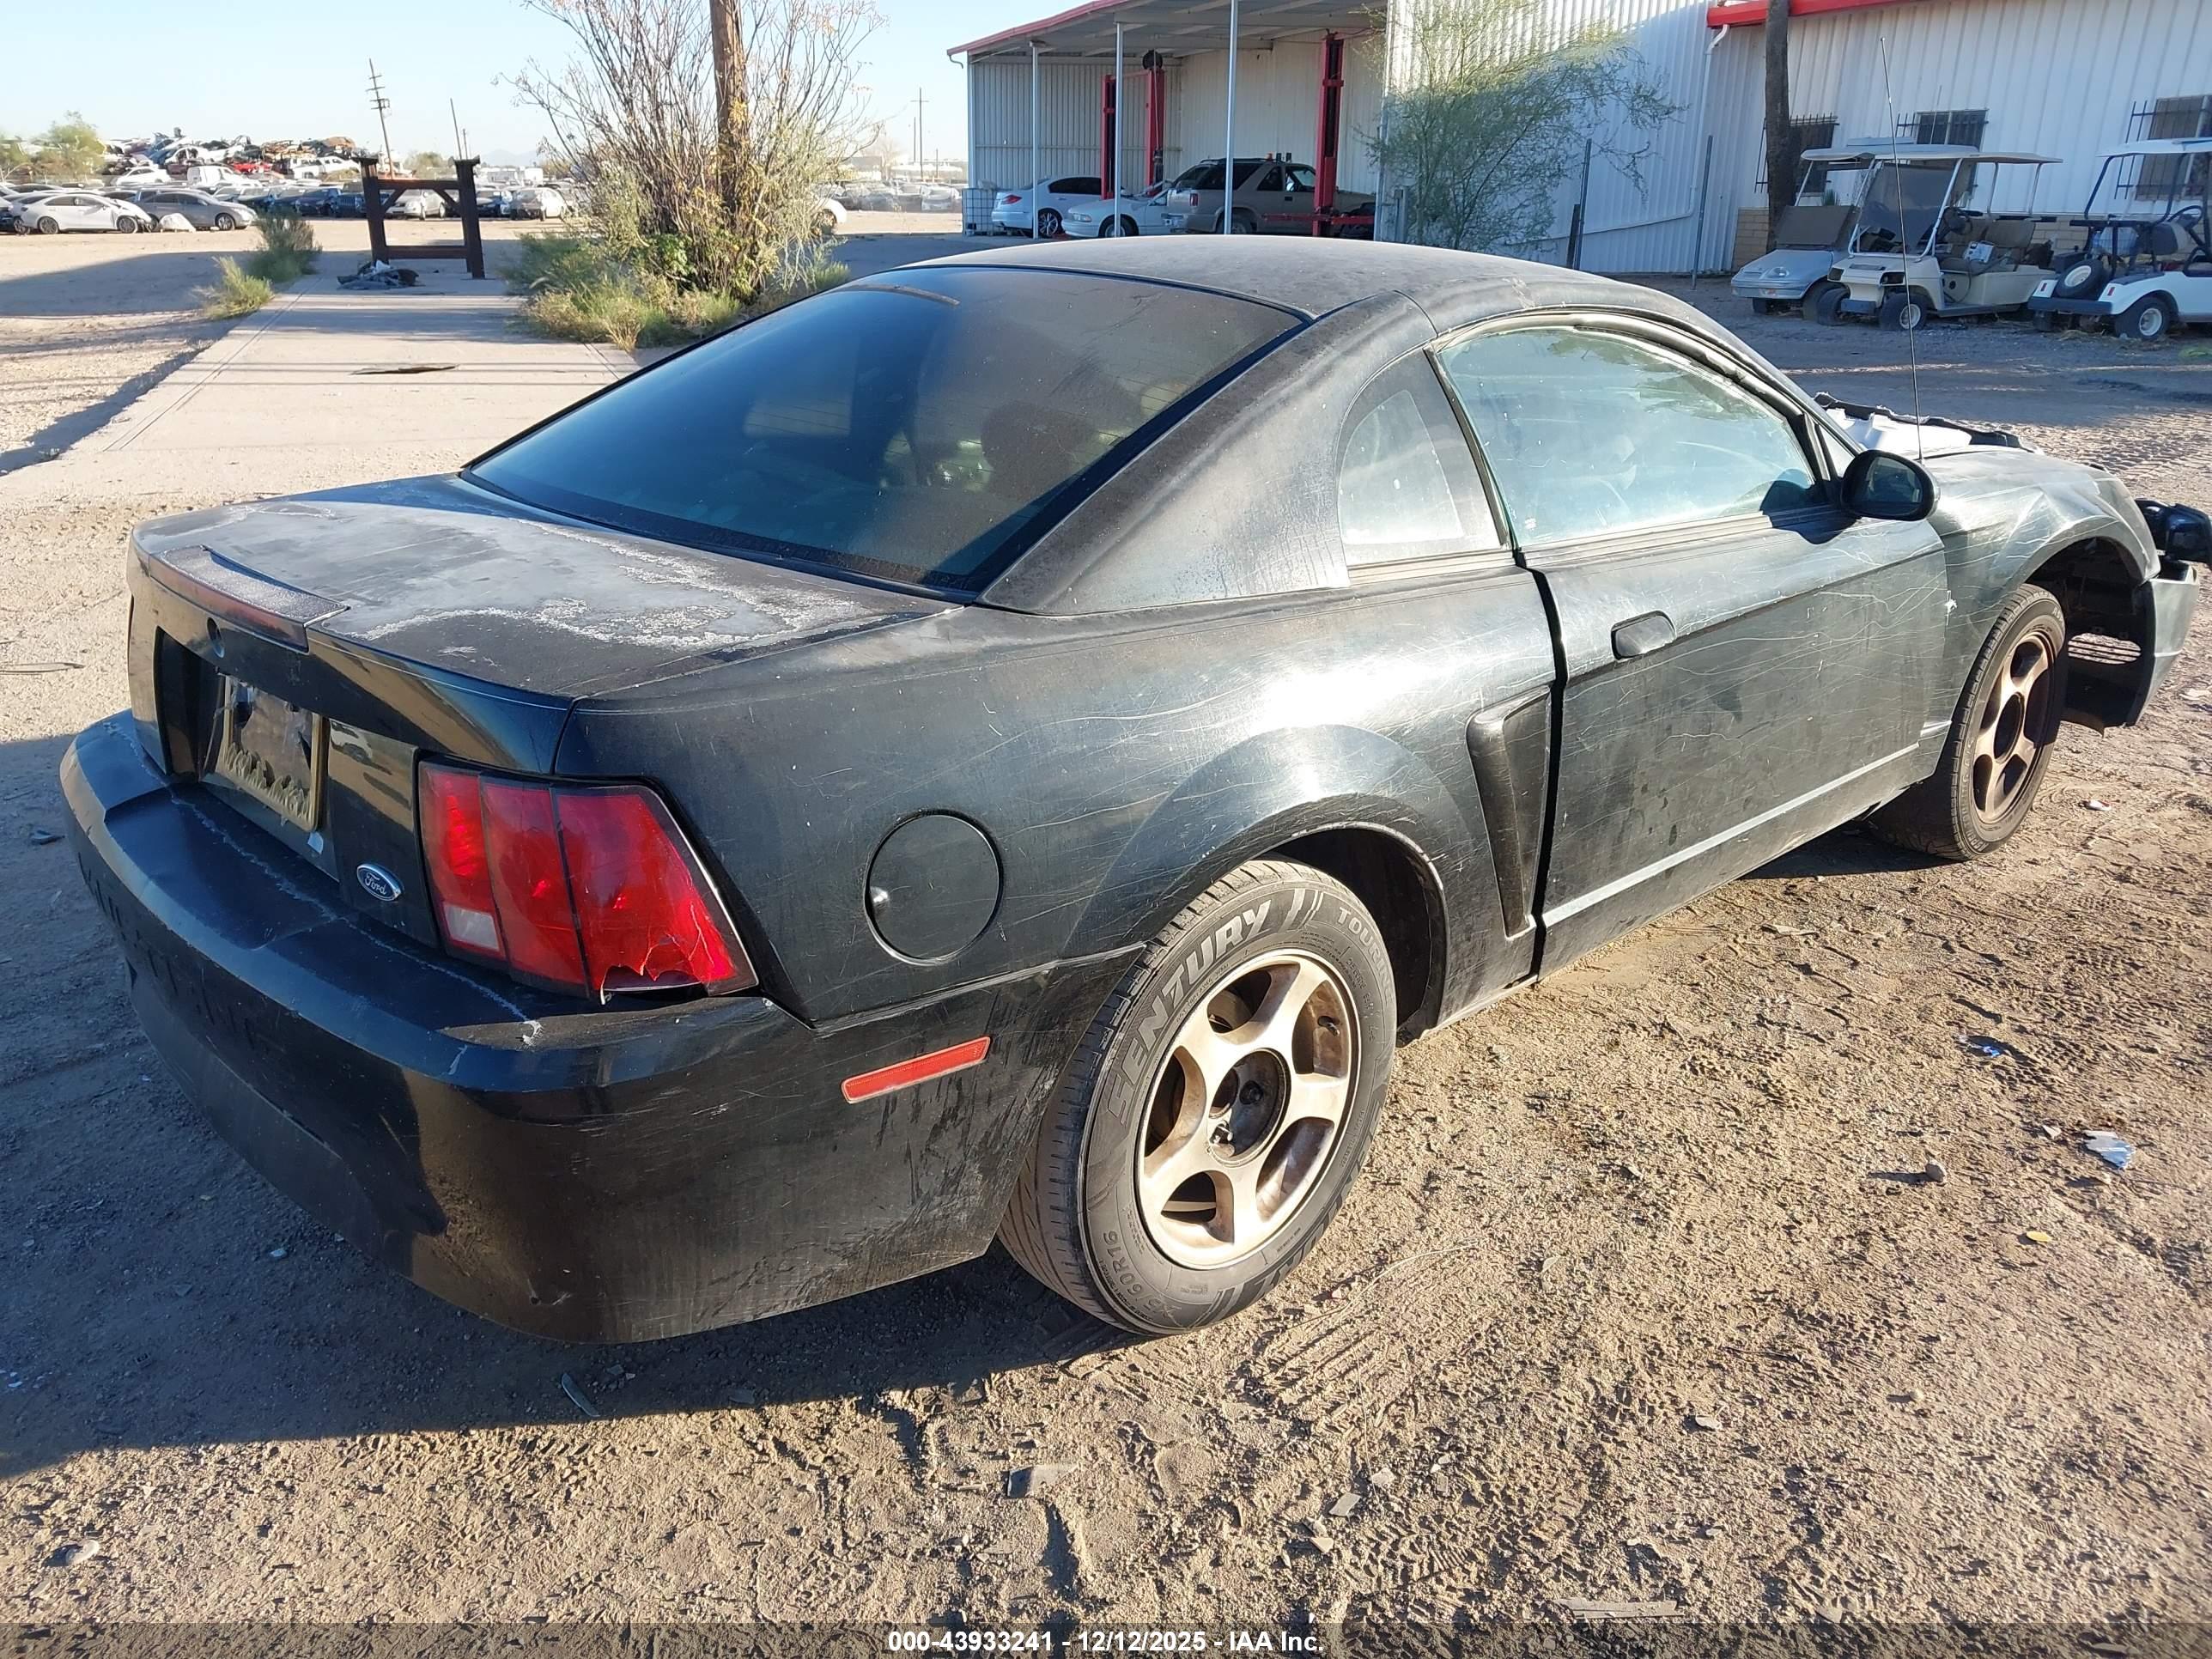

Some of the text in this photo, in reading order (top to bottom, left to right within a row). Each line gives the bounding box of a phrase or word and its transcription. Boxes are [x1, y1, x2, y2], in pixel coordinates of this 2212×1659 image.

[365, 872, 387, 895] Ford
[1107, 899, 1395, 1126] SENTURY TOURING
